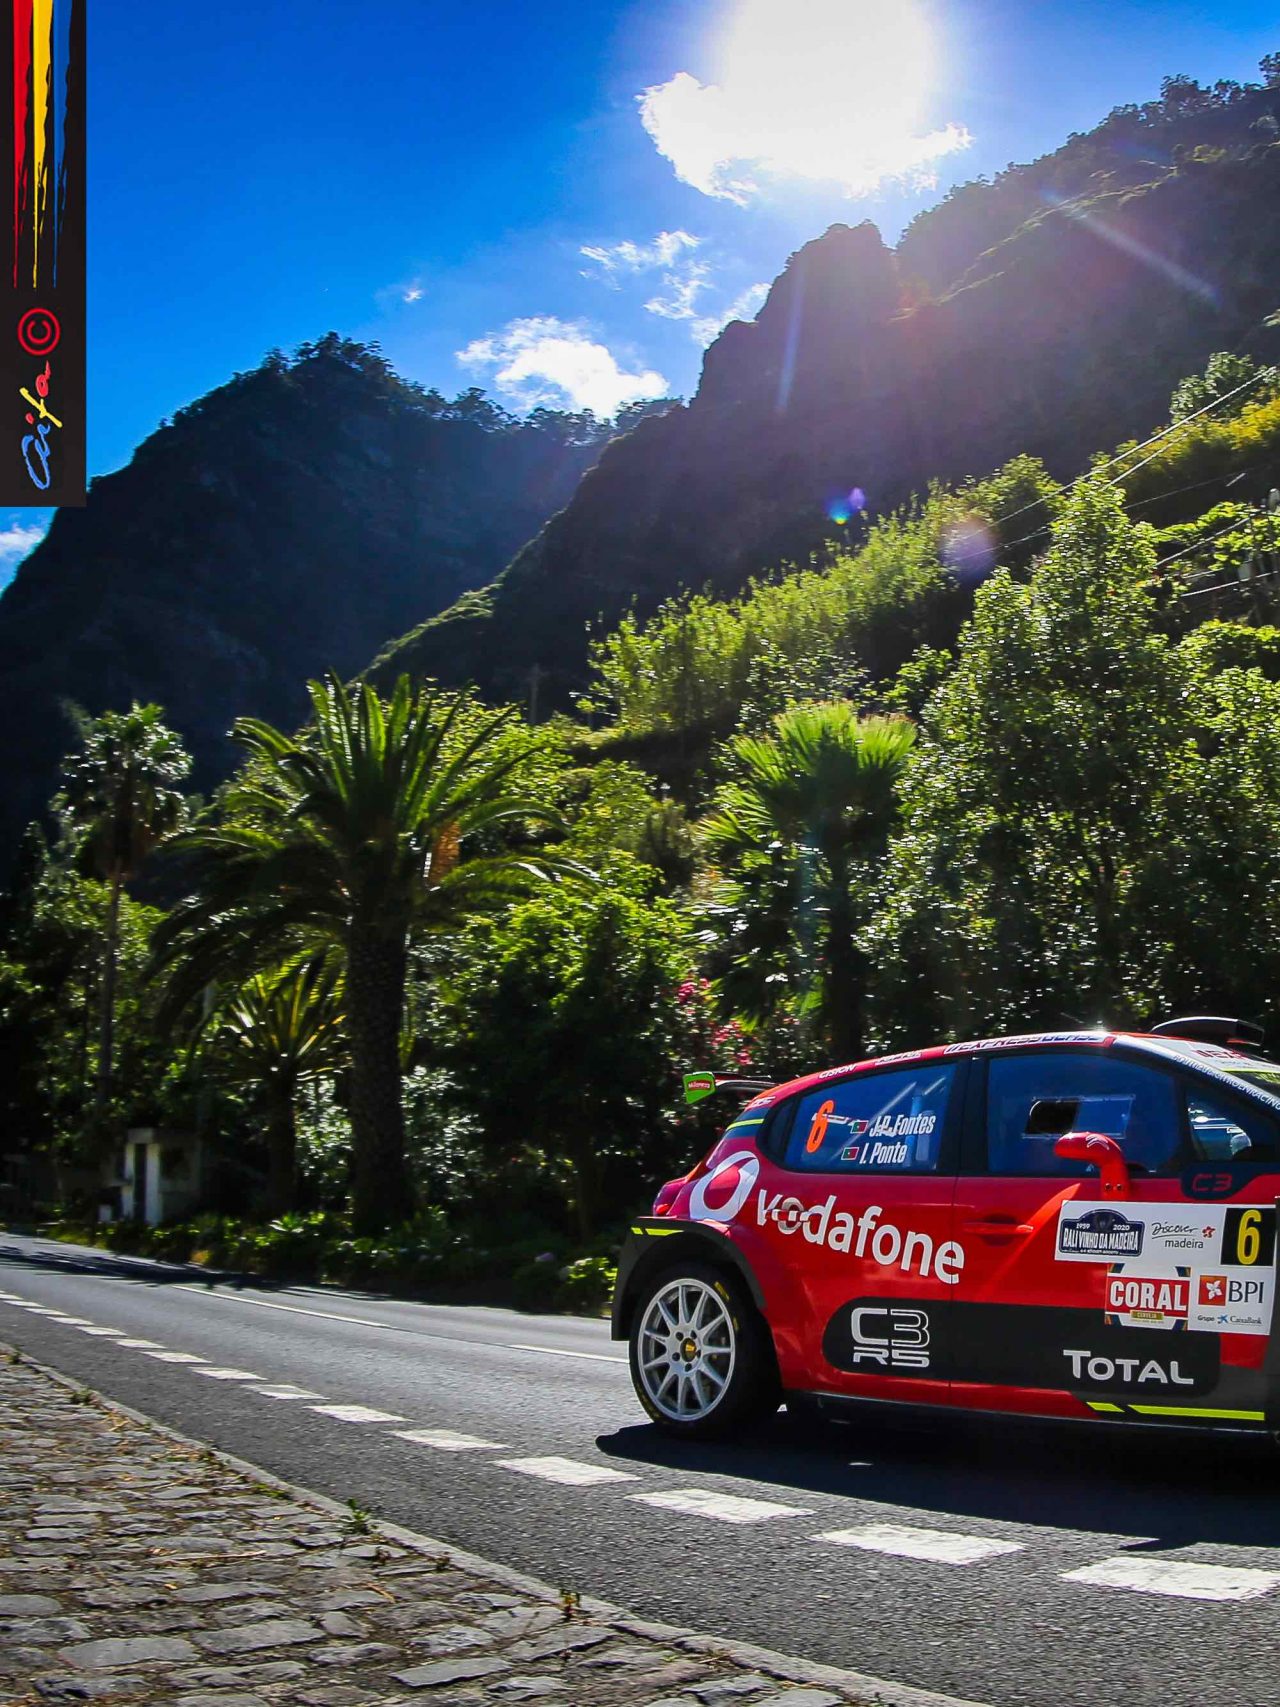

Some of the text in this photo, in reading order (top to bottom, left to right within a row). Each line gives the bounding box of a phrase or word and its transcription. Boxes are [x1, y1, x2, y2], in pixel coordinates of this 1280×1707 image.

[806, 1099, 834, 1153] 6
[869, 1141, 908, 1164] Ponte
[1192, 1173, 1233, 1192] C3
[757, 1189, 965, 1284] vodafone
[1063, 1228, 1139, 1250] RALI VINHO DA MADEIRA
[1151, 1221, 1199, 1236] Discover
[1237, 1209, 1262, 1265] 6
[1164, 1238, 1204, 1249] madeira
[1109, 1280, 1187, 1312] CORAL
[1228, 1281, 1264, 1304] BPI
[850, 1307, 930, 1348] C3
[853, 1346, 930, 1368] RS
[1063, 1349, 1194, 1385] TOTAL
